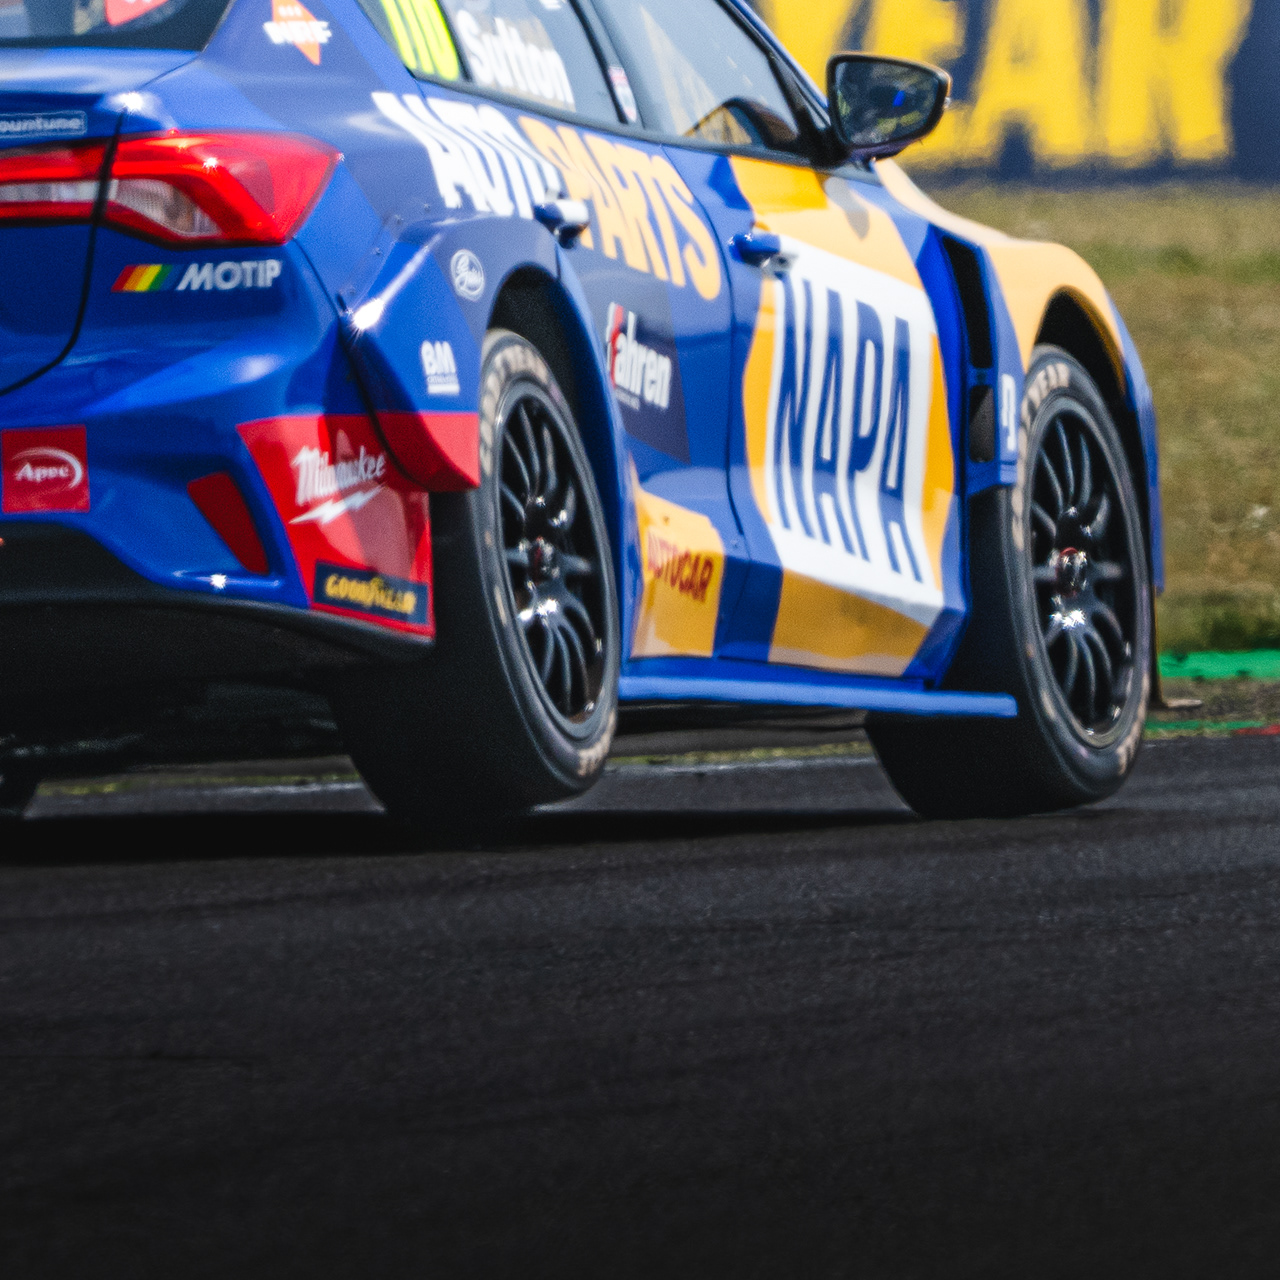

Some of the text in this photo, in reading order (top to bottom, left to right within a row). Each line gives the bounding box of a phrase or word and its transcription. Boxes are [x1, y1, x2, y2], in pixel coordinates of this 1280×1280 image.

[457, 9, 575, 105] Sutton
[176, 259, 282, 291] MOTIP
[773, 270, 924, 584] NAPA
[290, 445, 386, 507] Milwaukee
